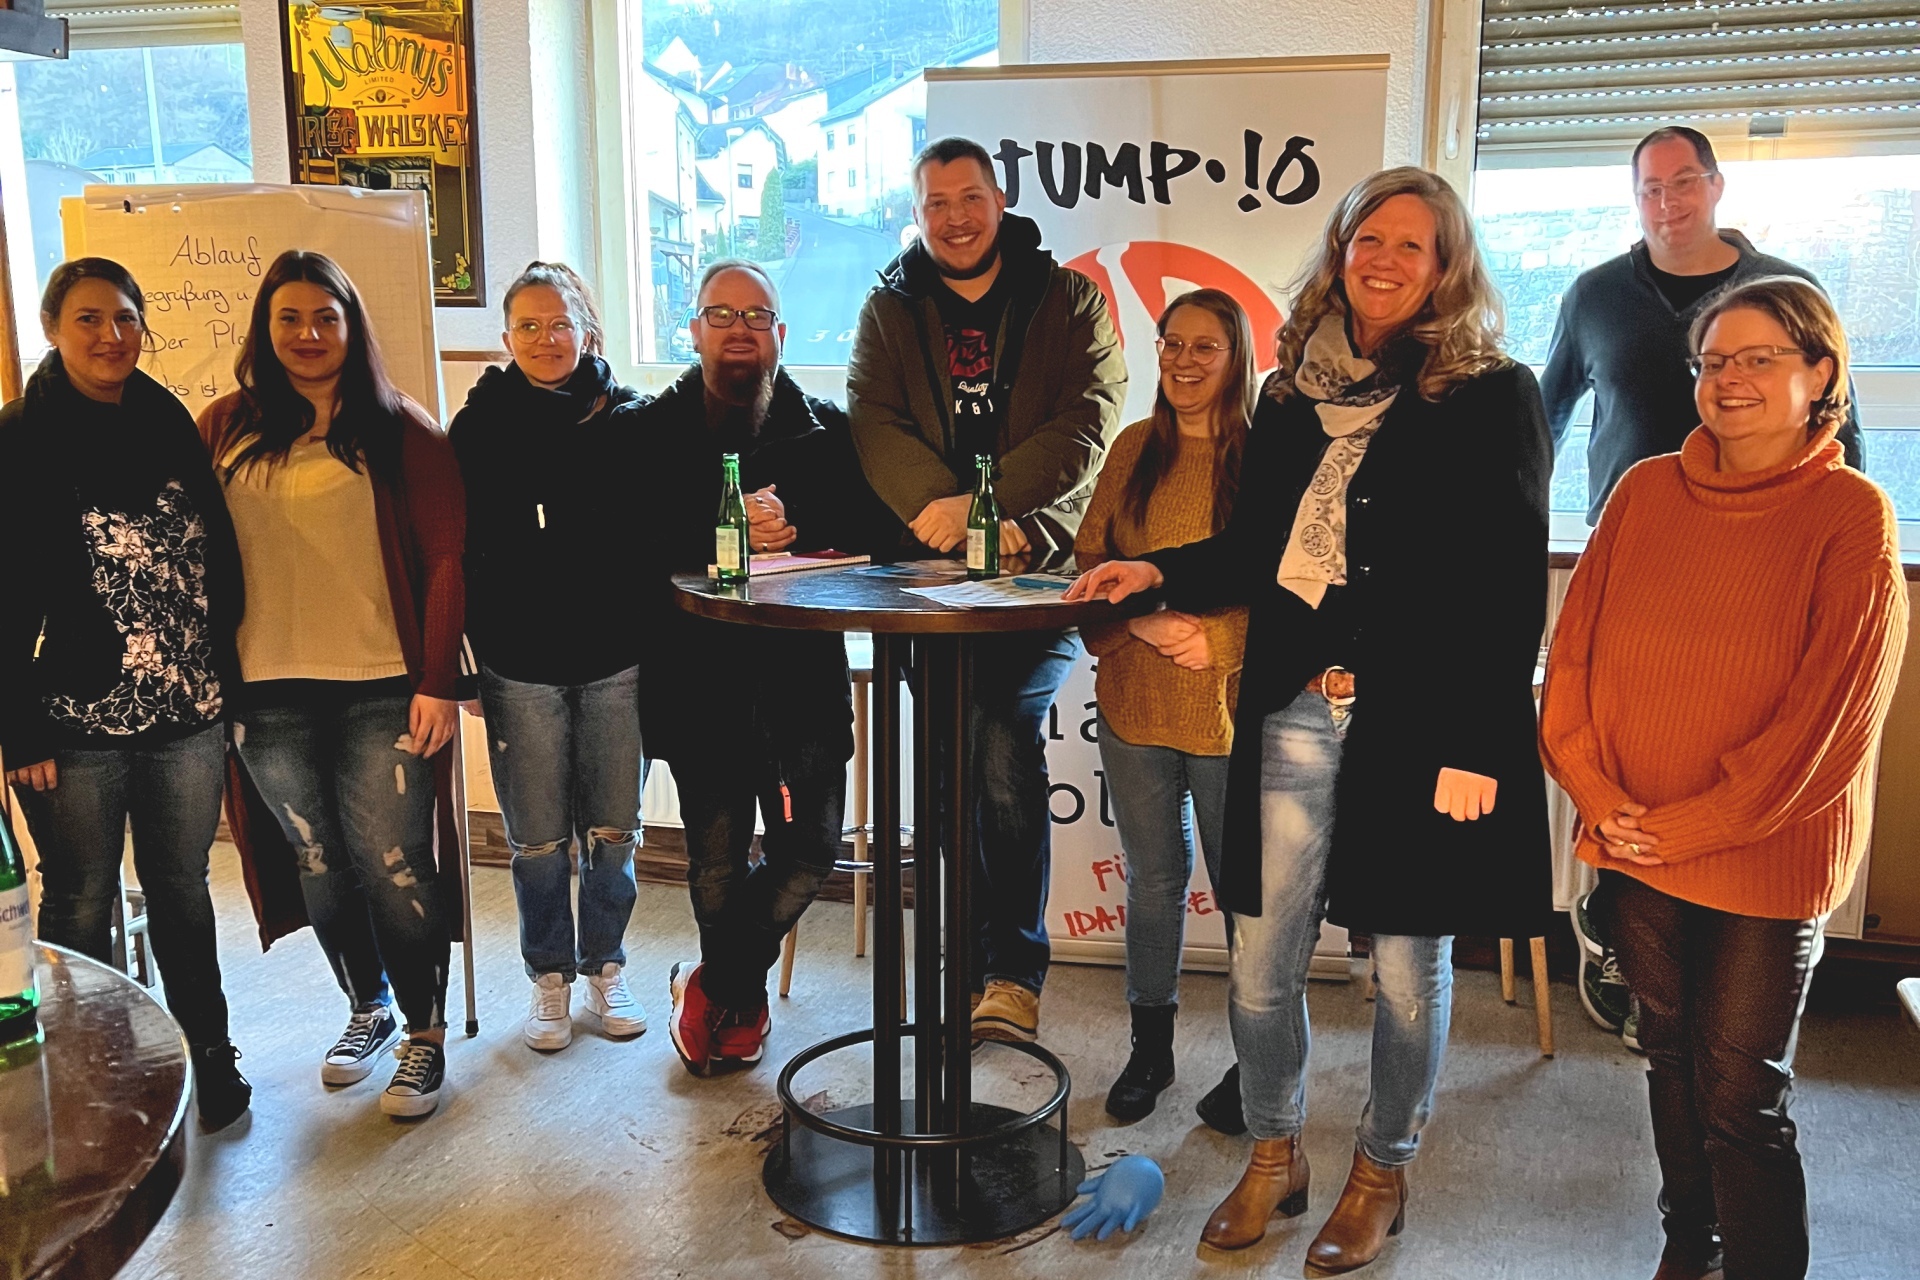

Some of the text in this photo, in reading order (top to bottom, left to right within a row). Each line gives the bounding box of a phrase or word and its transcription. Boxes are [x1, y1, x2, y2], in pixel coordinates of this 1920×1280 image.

[364, 75, 396, 86] LIMITED
[297, 114, 469, 152] IRISH WHISKEY
[169, 234, 262, 277] Ablauf
[144, 280, 230, 313] egrüßung
[141, 330, 190, 353] Der
[200, 374, 219, 398] ist
[957, 380, 989, 397] Quality
